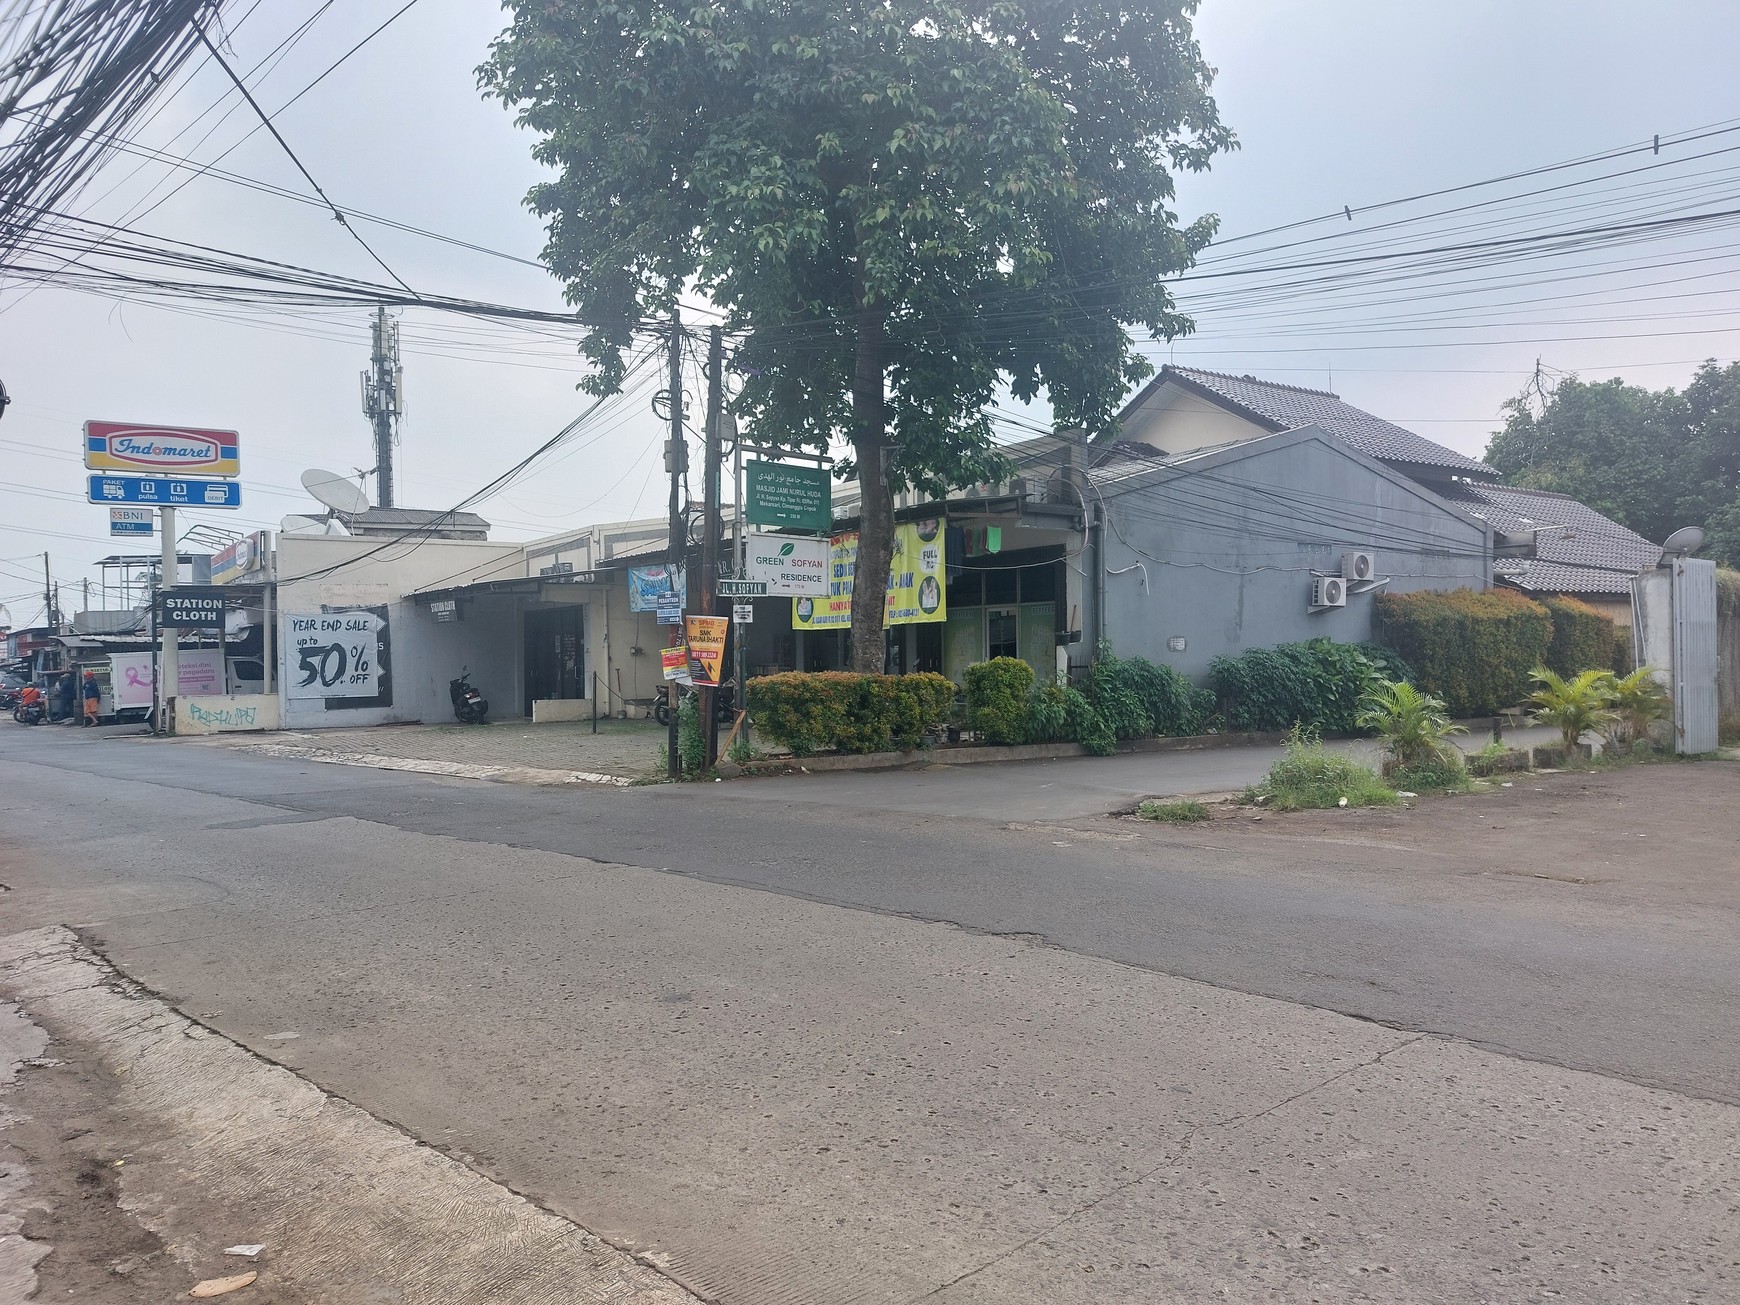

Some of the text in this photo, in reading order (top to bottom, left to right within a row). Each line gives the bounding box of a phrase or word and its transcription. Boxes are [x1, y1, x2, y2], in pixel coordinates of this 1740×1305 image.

[114, 438, 212, 458] Indomaret
[775, 474, 785, 483] نور
[786, 475, 802, 486] جامع
[755, 484, 776, 493] MASJID
[789, 488, 807, 497] NURUL
[807, 490, 822, 499] HUDA
[123, 512, 143, 521] BNI
[922, 550, 938, 560] FULL
[756, 556, 823, 568] GREEN SOFYAN
[780, 573, 822, 582] RESIDENCE
[166, 599, 222, 609] STATION
[172, 610, 217, 621] CLOTH
[293, 618, 369, 632] YEAR END SALE
[296, 636, 318, 646] up to
[349, 674, 370, 685] OFF
